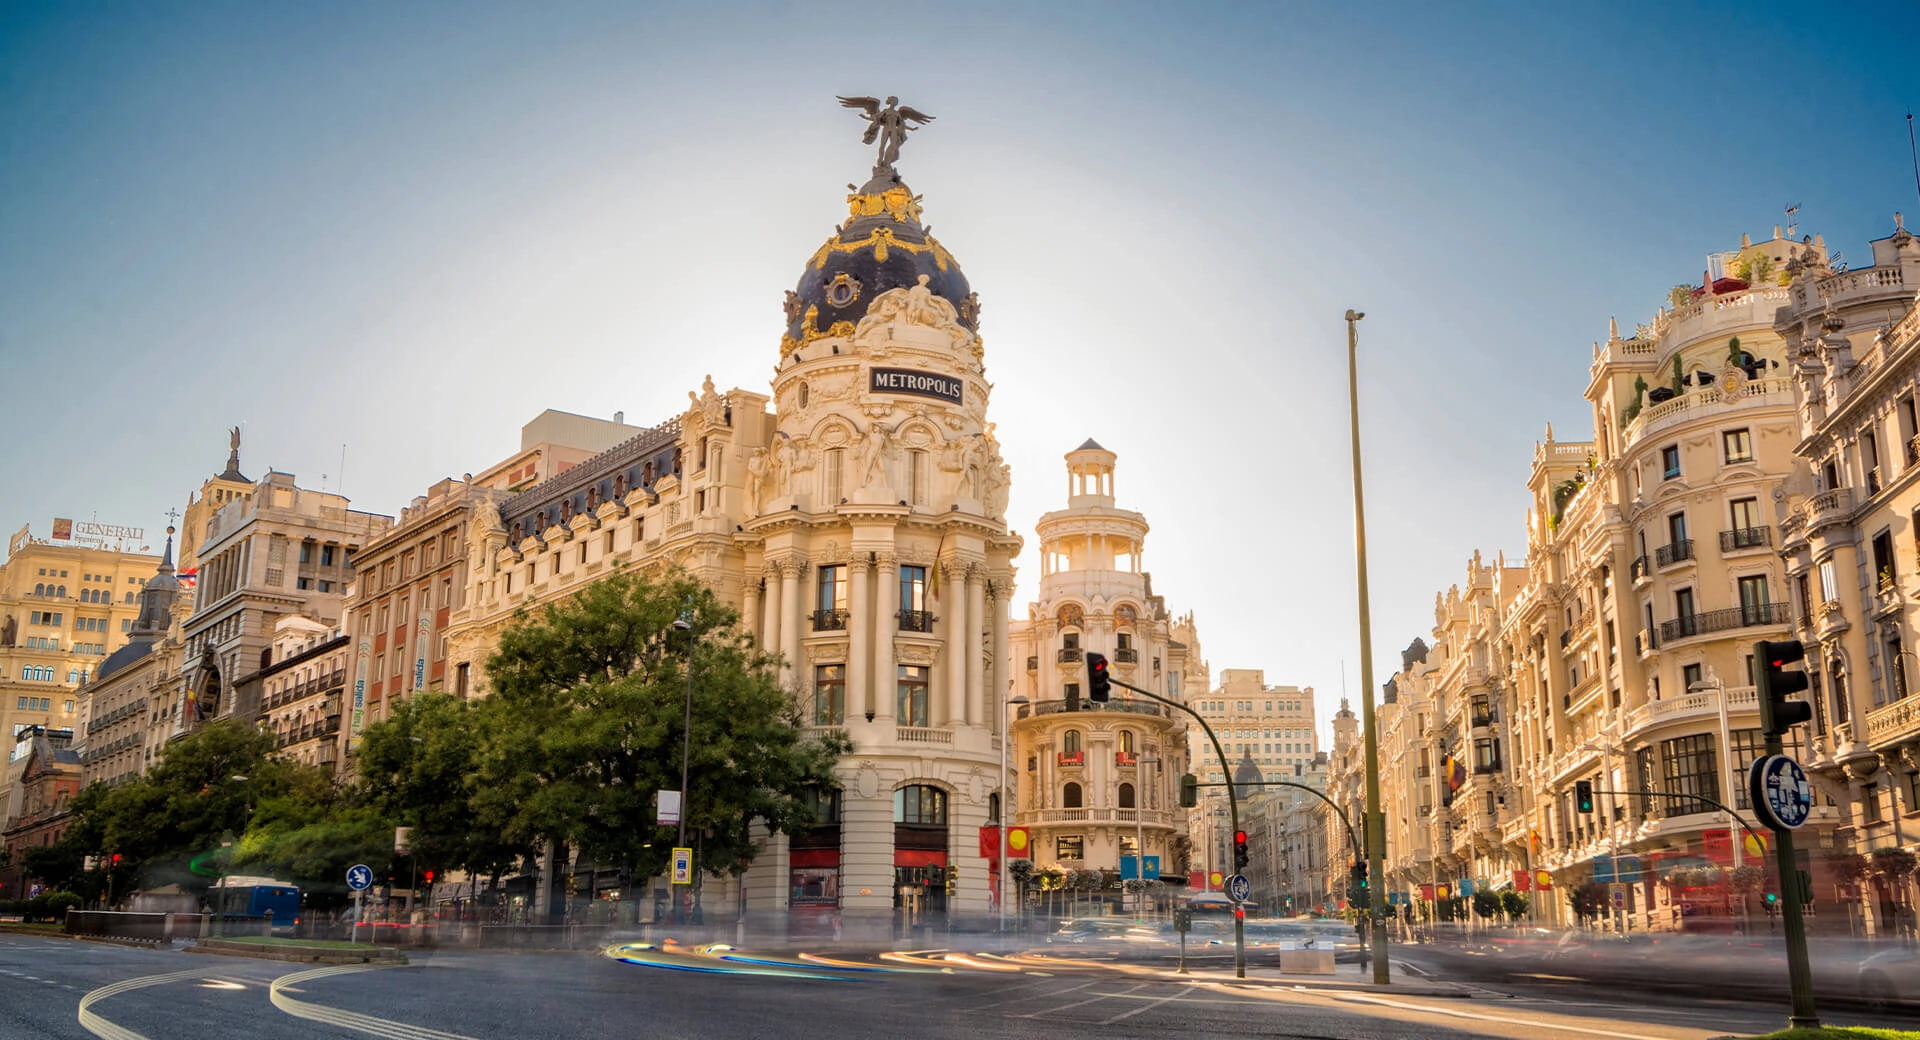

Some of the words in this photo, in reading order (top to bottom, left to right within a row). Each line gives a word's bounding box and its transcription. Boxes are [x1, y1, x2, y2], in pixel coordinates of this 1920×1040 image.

[875, 373, 960, 398] METROPOLIS
[76, 522, 144, 540] GENERALI
[416, 658, 425, 688] salida
[354, 680, 365, 708] salida
